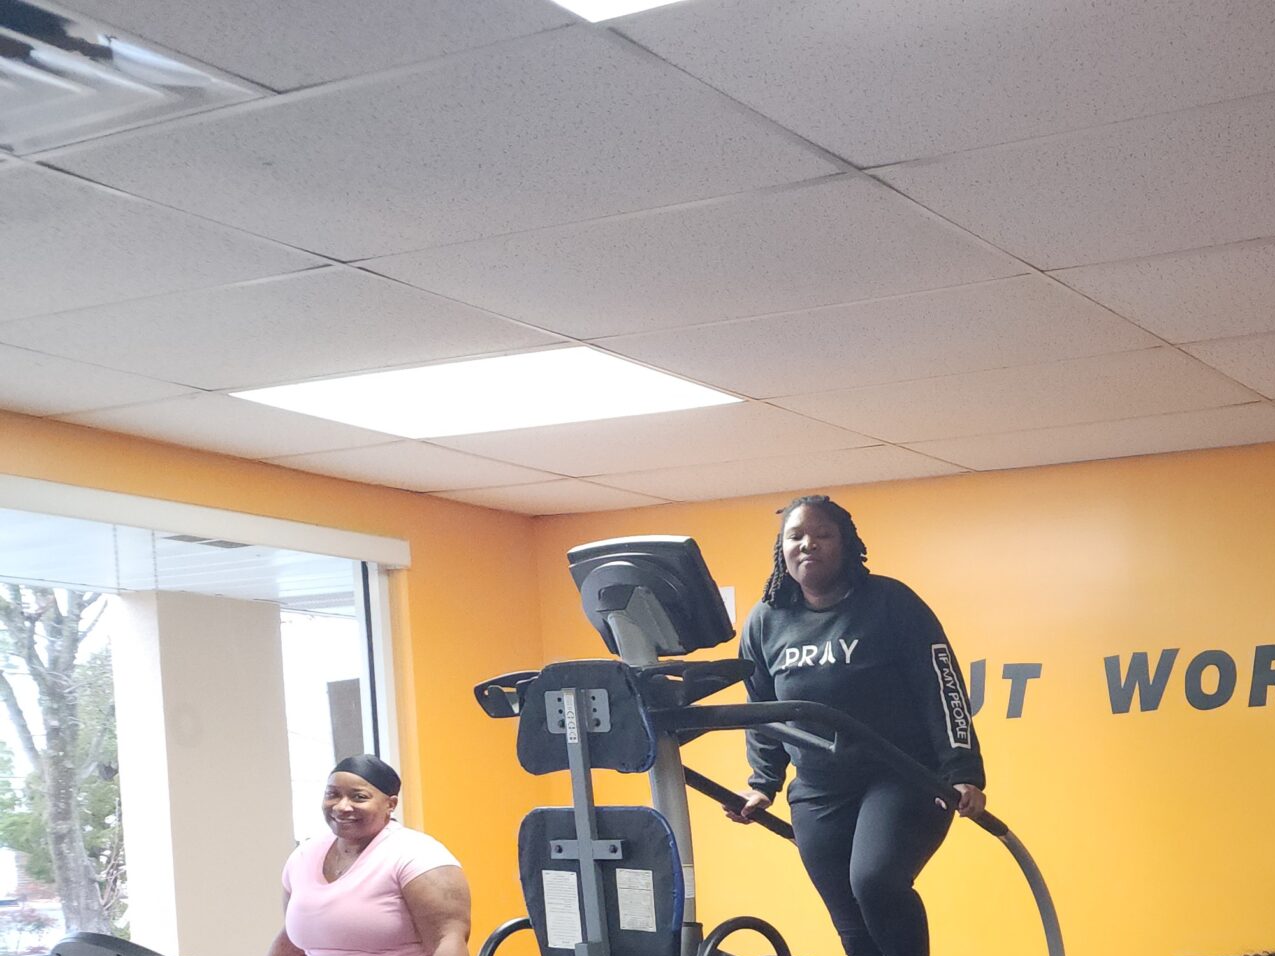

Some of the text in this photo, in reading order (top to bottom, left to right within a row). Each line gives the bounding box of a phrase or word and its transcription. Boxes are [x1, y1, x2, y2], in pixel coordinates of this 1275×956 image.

[781, 639, 859, 670] PRAY
[938, 652, 968, 739] IF MY PEOPLE
